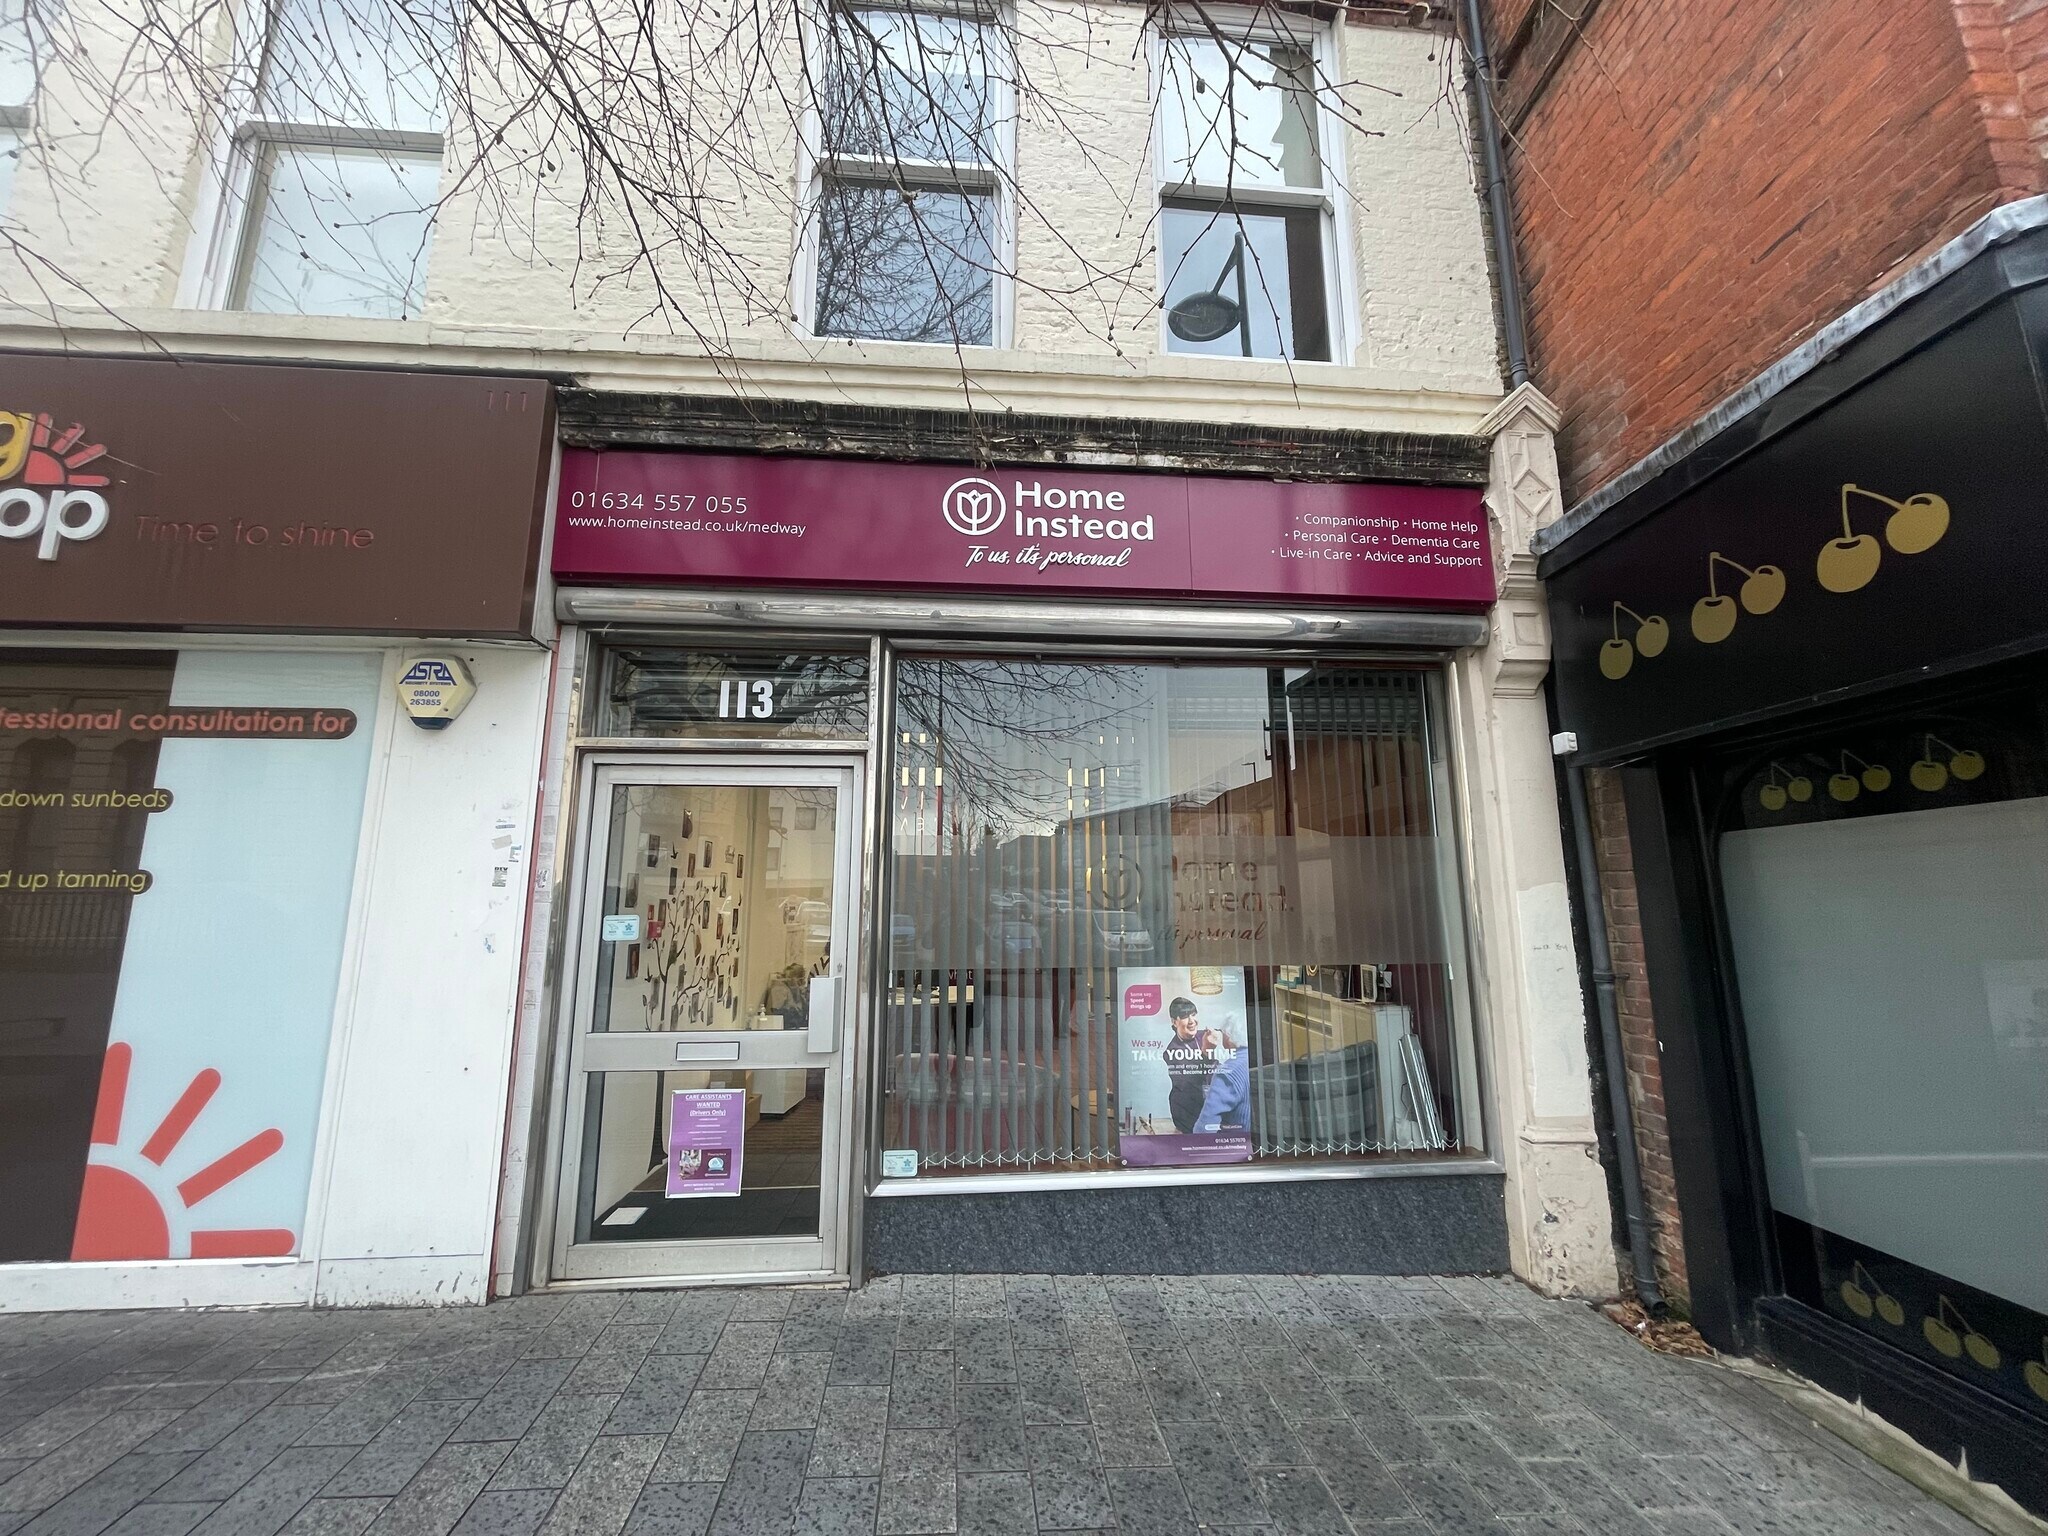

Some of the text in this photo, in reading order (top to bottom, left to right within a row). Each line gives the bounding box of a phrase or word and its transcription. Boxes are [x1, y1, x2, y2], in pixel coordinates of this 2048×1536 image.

[571, 490, 748, 514] 01634 557 055
[1014, 480, 1126, 511] Home
[136, 514, 375, 549] Time to shine
[568, 515, 807, 538] www.homeinstead.co.uk/medway
[1014, 509, 1155, 541] Instead
[1303, 513, 1479, 534] Companionship Home Help
[1293, 530, 1480, 550] Personal Care Dementia Care
[964, 543, 1132, 571] To us, it's personal
[1279, 547, 1483, 568] Live-in Care Advice and Support
[399, 661, 457, 686] ASTRA
[409, 698, 442, 706] 263855
[413, 689, 441, 698] 08000
[719, 680, 773, 718] 113
[129, 709, 304, 732] consultation
[312, 711, 350, 732] for
[0, 789, 168, 808] down sunbeds
[18, 873, 49, 892] up
[57, 869, 147, 892] tanning
[1132, 1048, 1237, 1061] TAKE YOUR TIME
